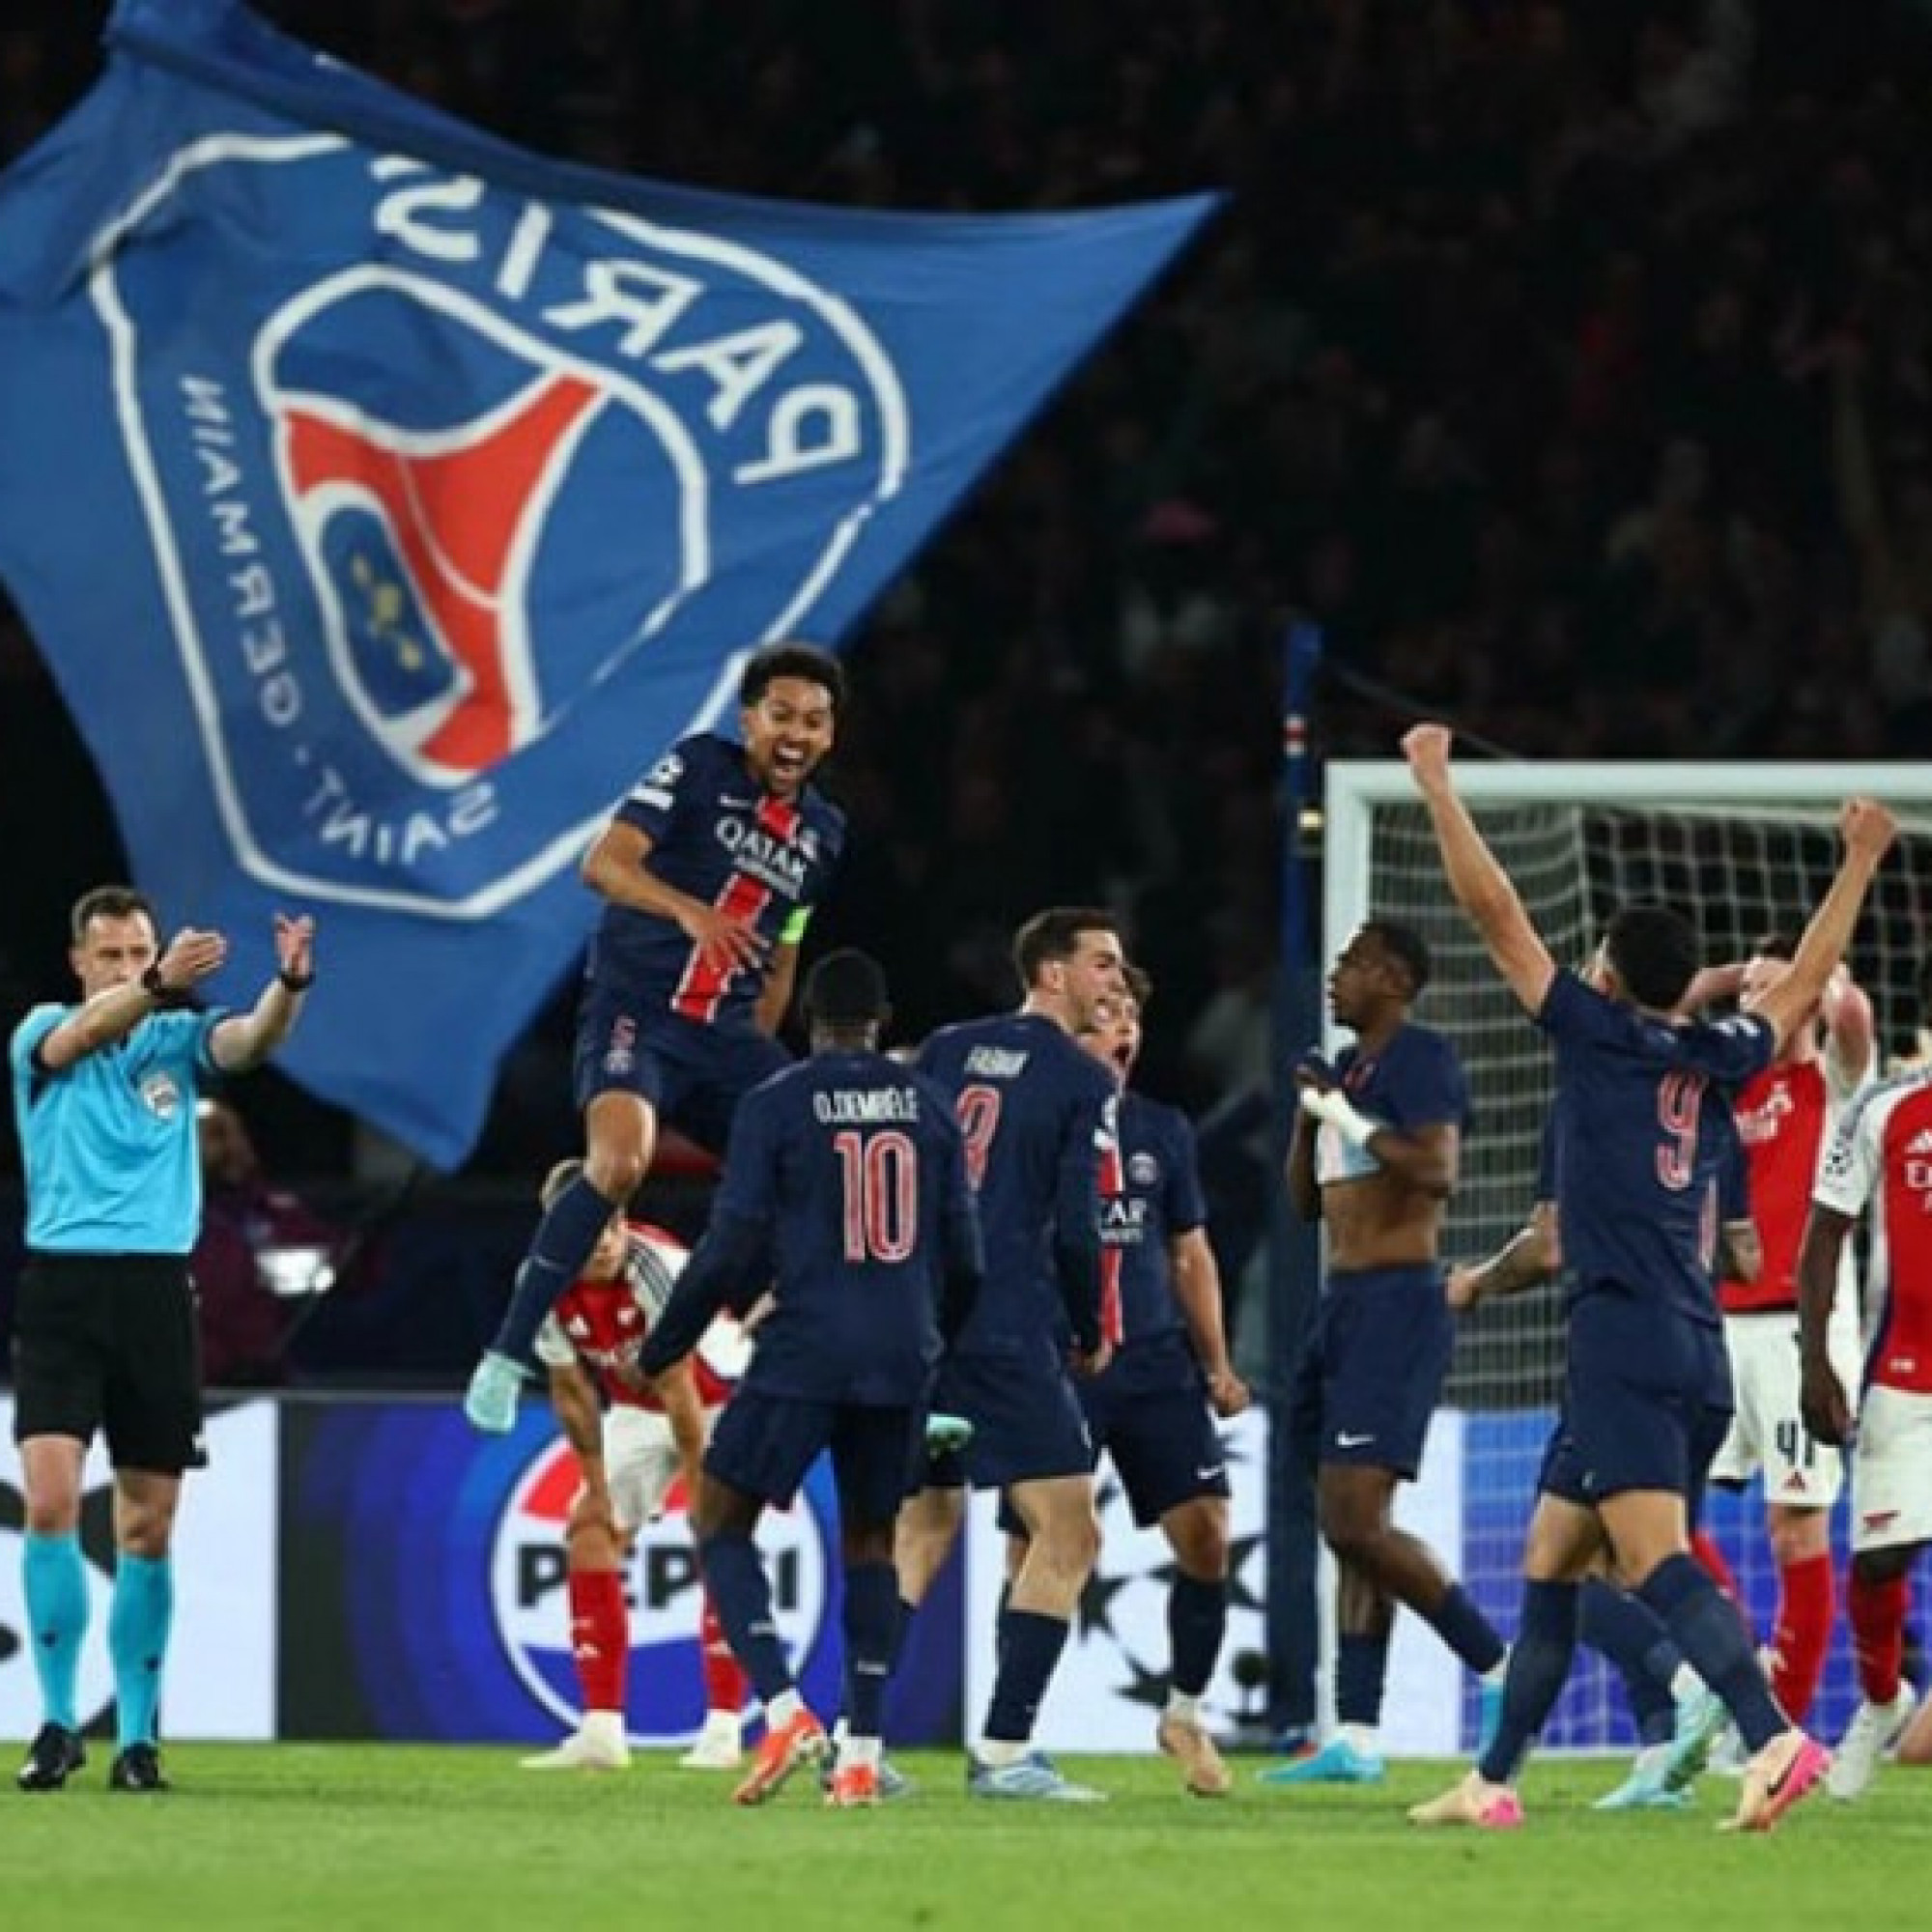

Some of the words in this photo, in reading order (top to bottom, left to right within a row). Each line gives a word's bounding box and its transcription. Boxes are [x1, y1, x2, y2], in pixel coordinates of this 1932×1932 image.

[1657, 1070, 1707, 1189] 9
[833, 1130, 917, 1262] 10
[516, 1544, 800, 1610] PPI
